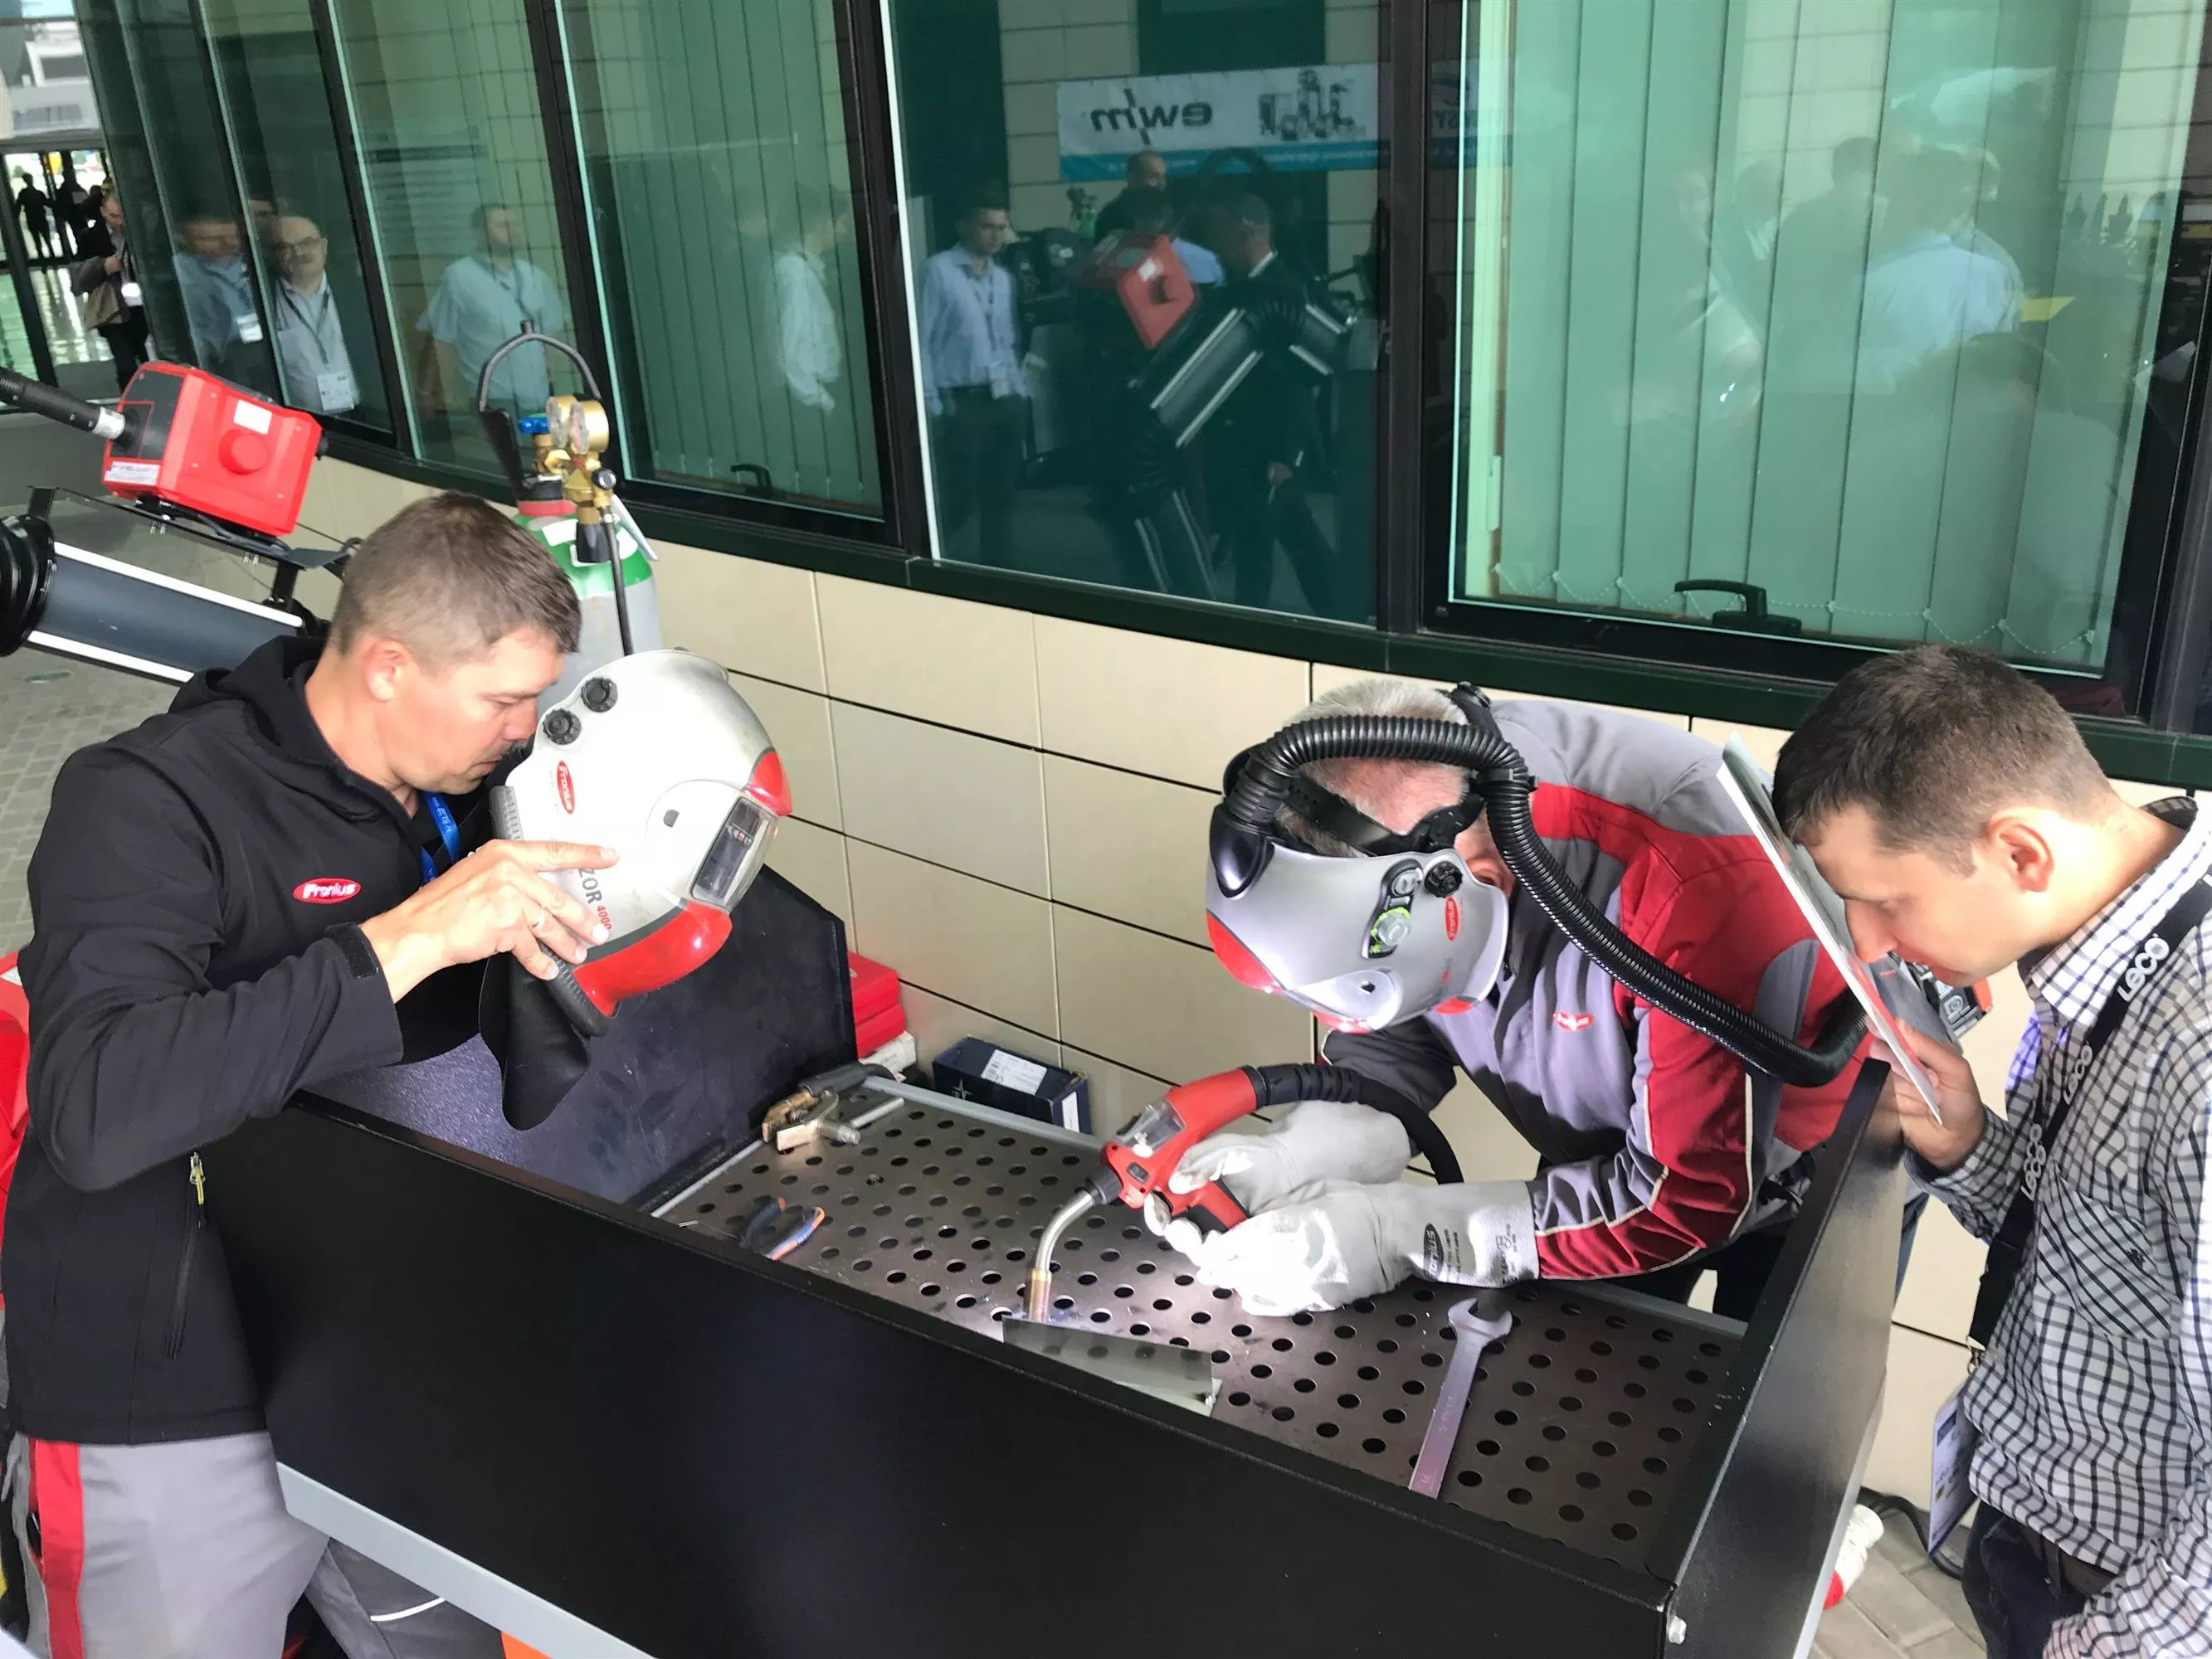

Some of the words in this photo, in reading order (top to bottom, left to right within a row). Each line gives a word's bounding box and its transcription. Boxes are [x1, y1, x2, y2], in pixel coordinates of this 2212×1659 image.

[301, 882, 358, 901] Fronius
[578, 868, 602, 904] ZOR
[597, 905, 612, 930] 4000
[1426, 1229, 1440, 1278] ronius
